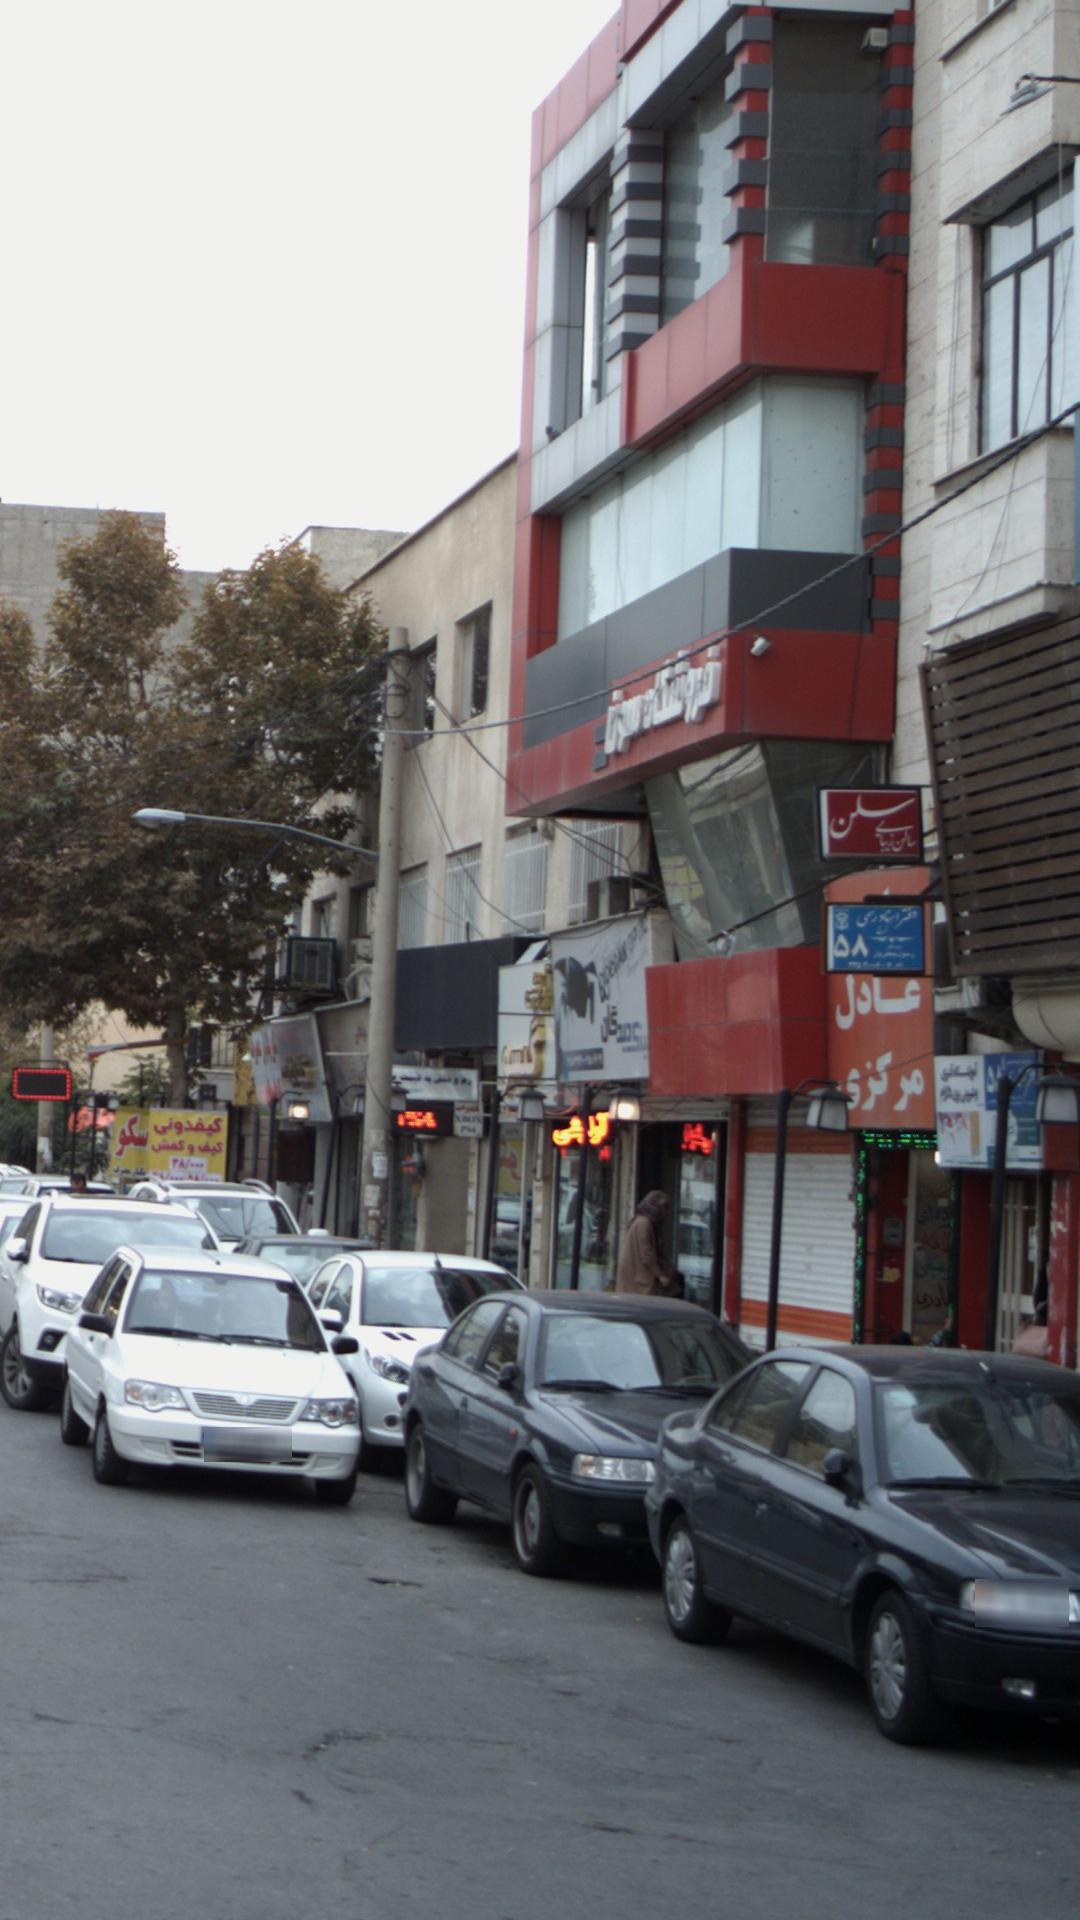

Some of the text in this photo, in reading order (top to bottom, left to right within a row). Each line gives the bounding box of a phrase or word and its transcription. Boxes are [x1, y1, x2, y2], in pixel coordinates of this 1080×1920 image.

[833, 933, 869, 958] ۵۸
[836, 972, 921, 1029] عادل
[846, 1052, 925, 1111] مرکزی
[151, 1139, 223, 1156] کیف و کفش
